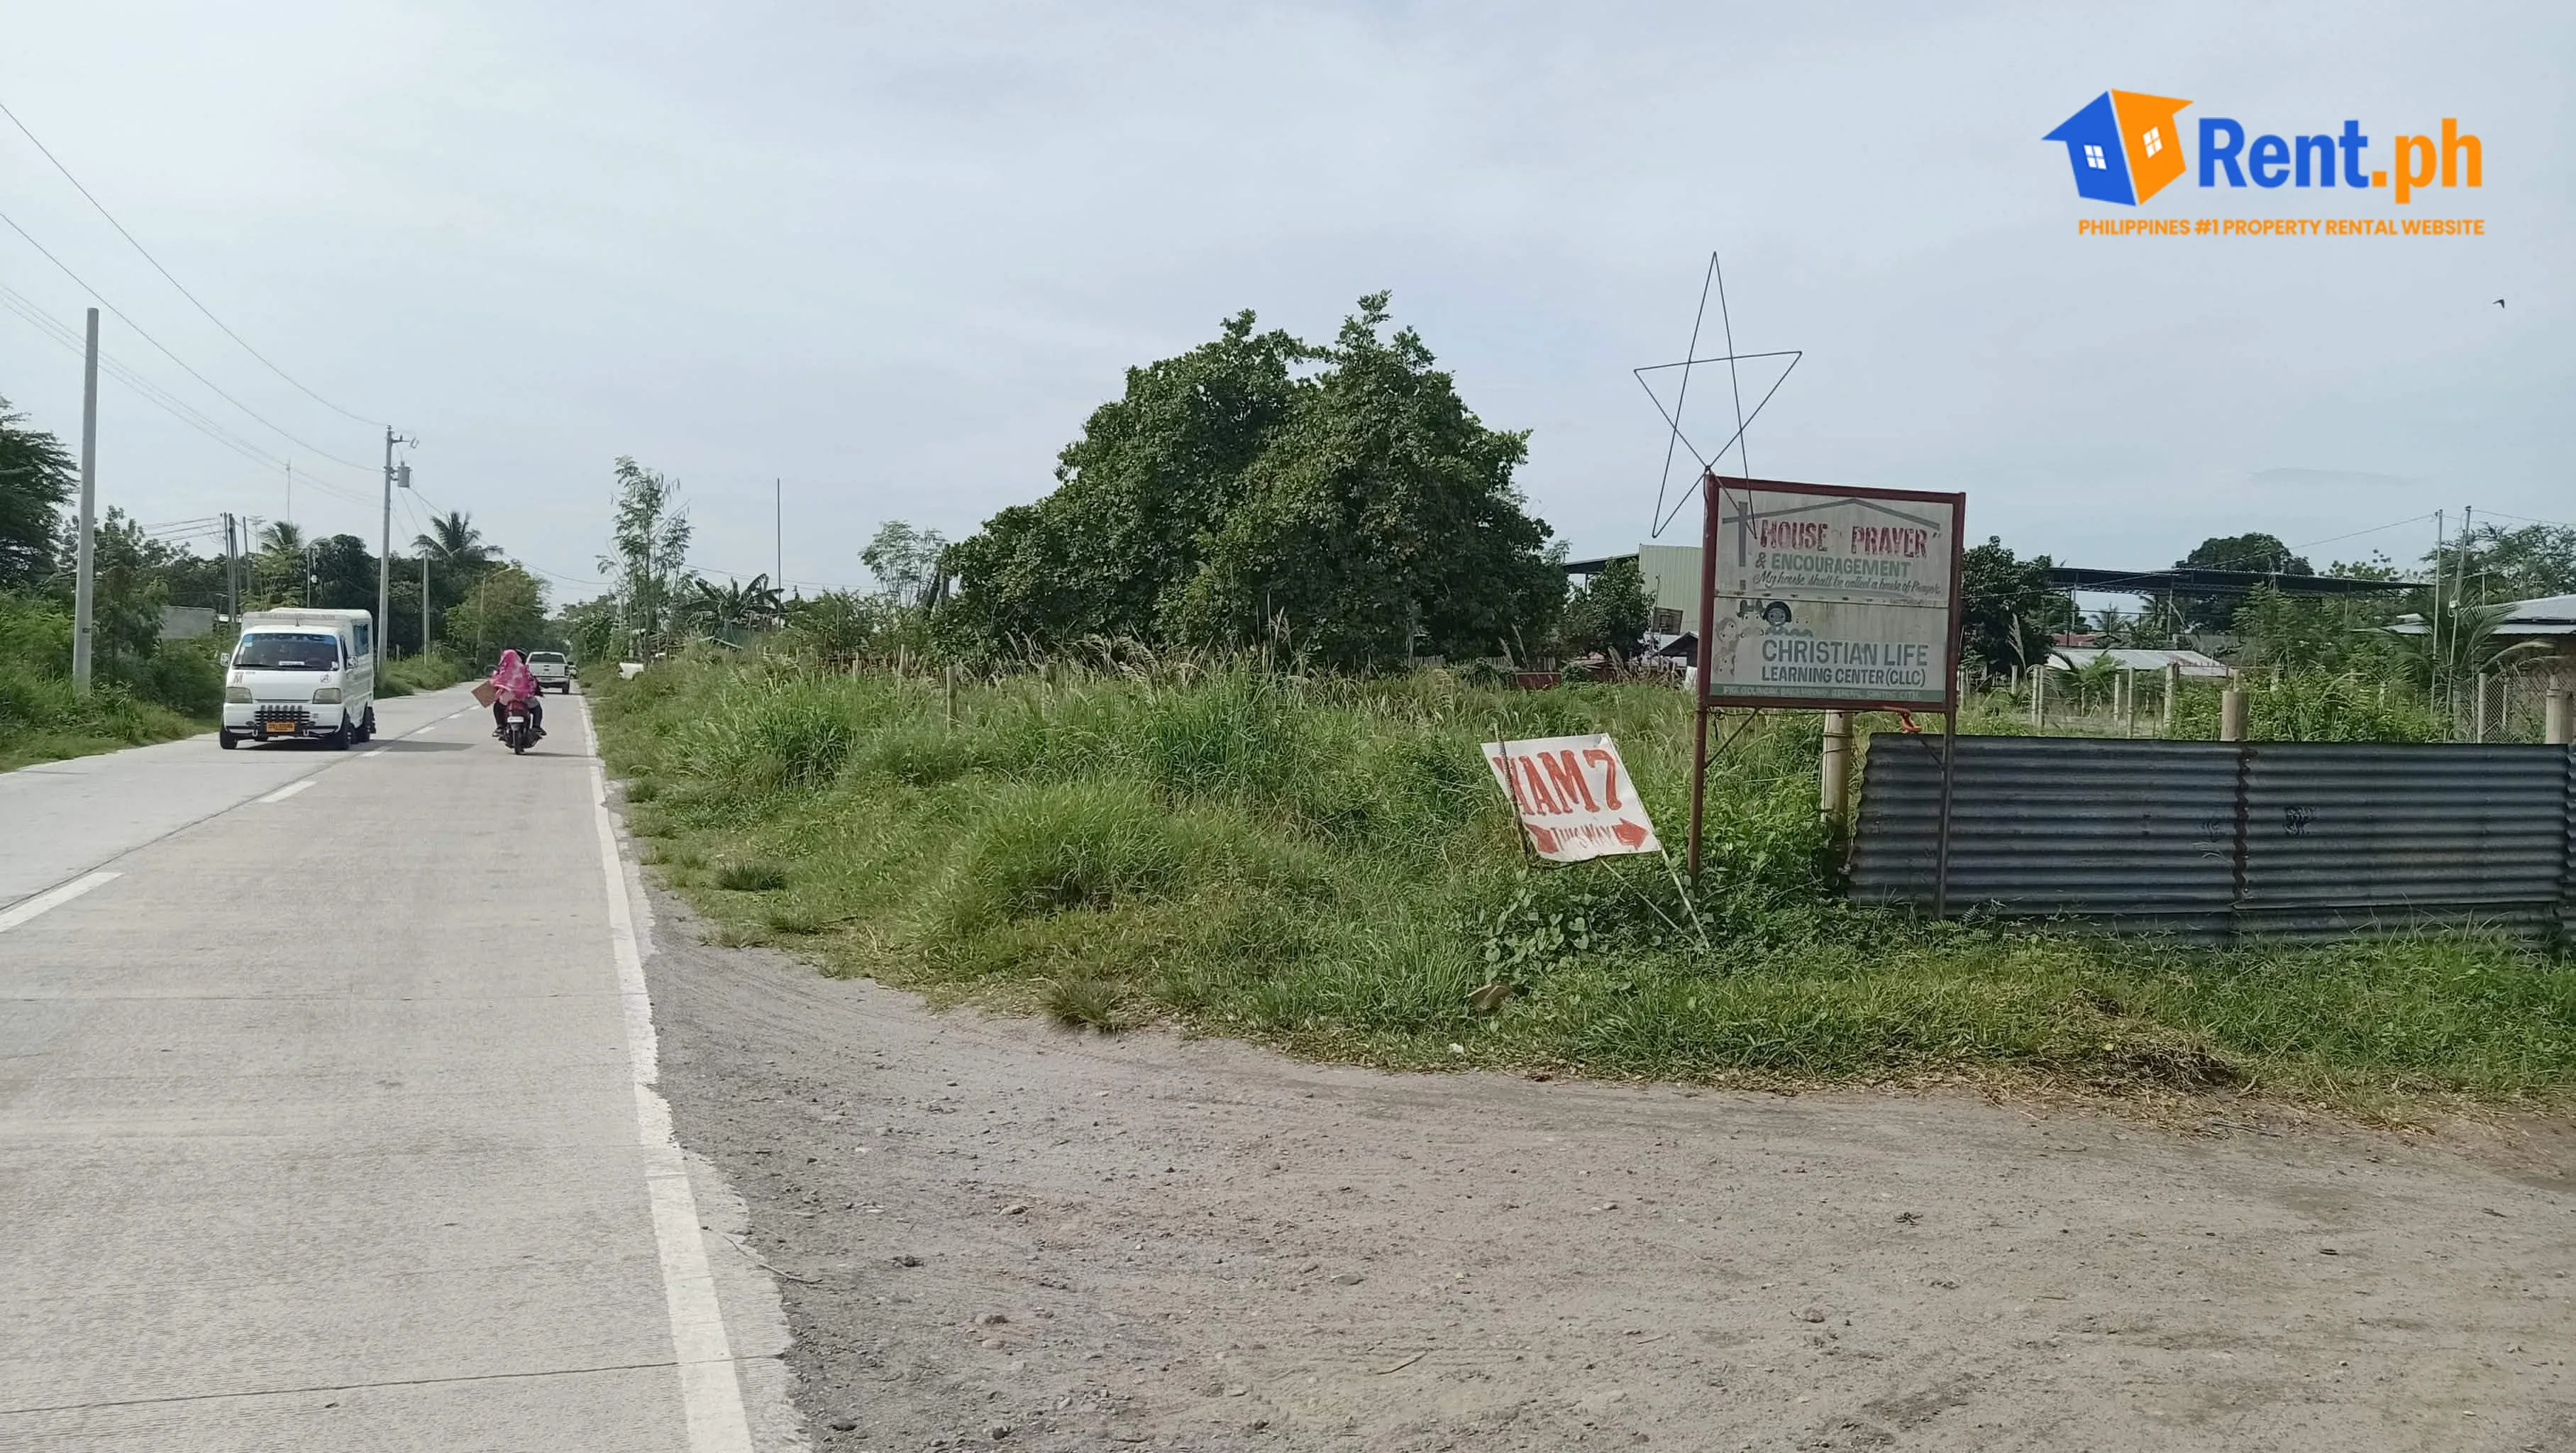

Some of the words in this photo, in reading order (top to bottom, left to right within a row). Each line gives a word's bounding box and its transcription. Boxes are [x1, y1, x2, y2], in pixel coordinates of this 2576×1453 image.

[1759, 519, 1828, 552] HOUSE
[1754, 552, 1767, 568] &
[1771, 553, 1912, 578] ENCOURAGEMENT
[1762, 639, 1878, 665] CHRISTIAN
[1884, 643, 1929, 666] LIFE
[1762, 665, 1832, 683] LEARNING
